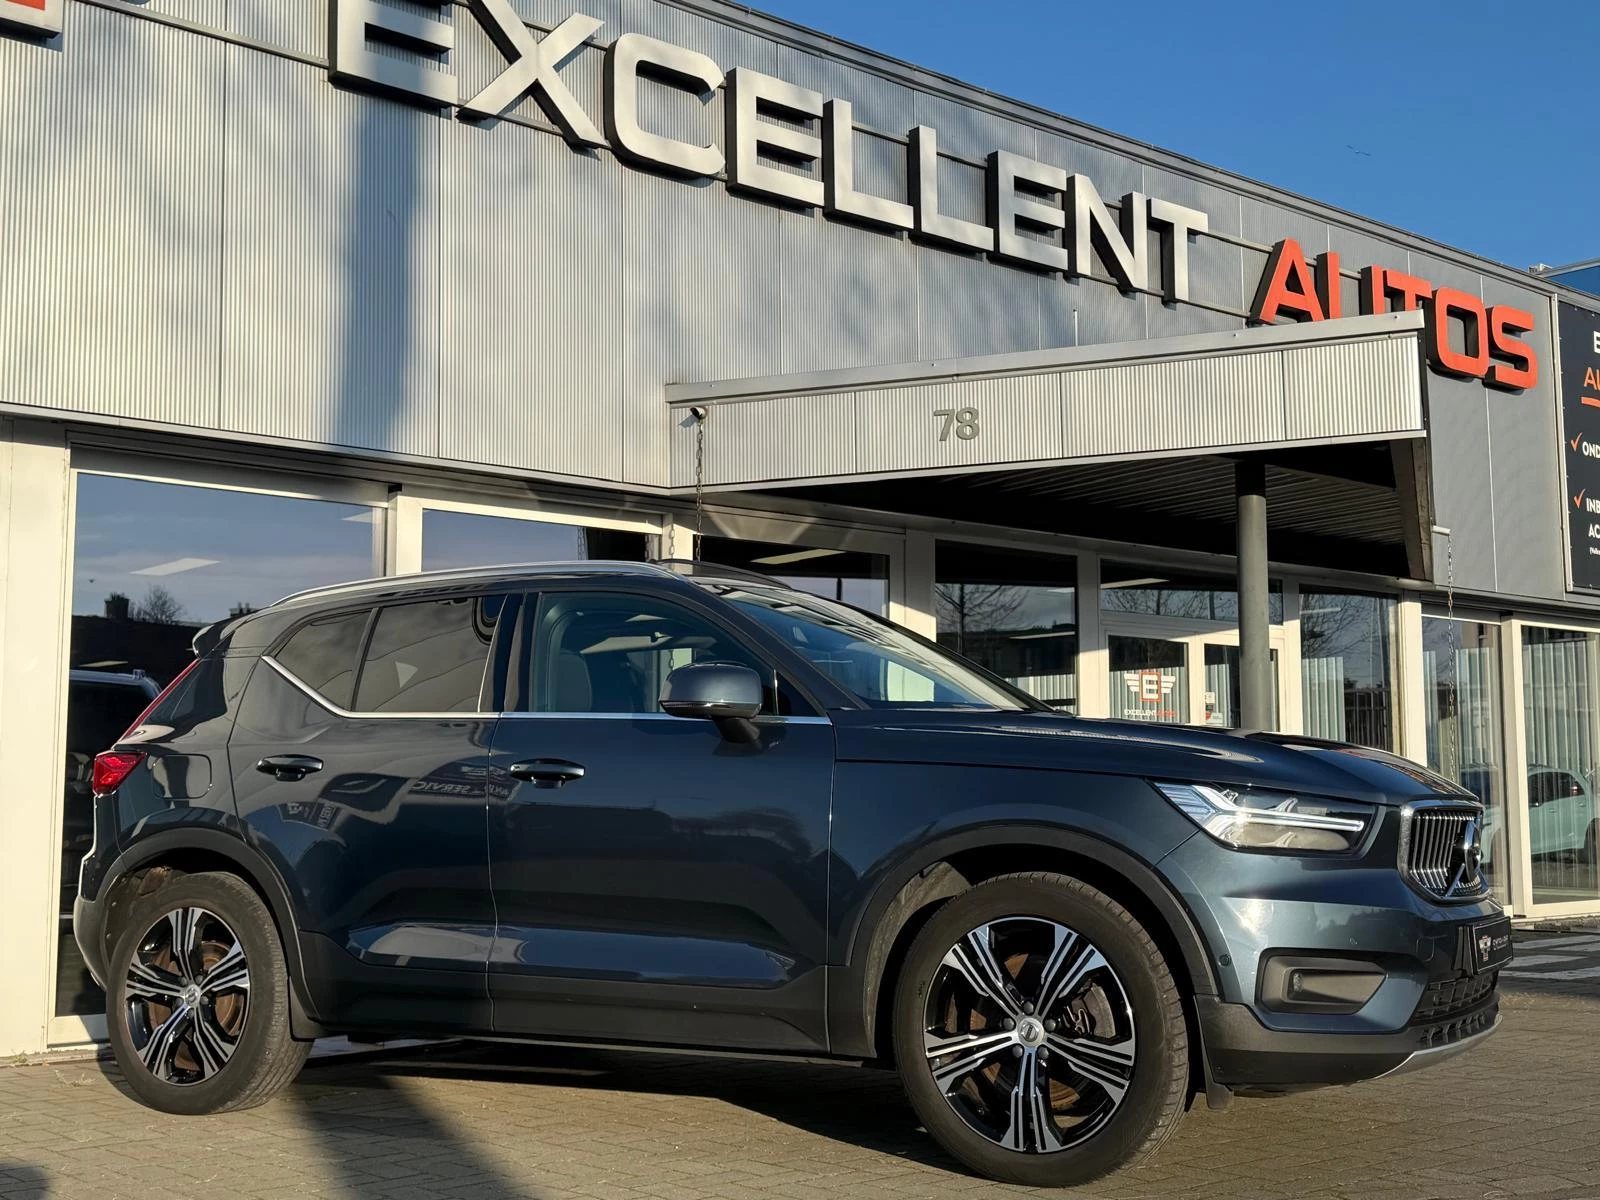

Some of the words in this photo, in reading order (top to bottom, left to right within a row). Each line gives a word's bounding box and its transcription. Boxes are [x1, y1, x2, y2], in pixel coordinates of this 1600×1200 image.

[330, 0, 1208, 302] EXCELLENT
[1252, 237, 1538, 390] AUTOS
[933, 406, 980, 442] 78
